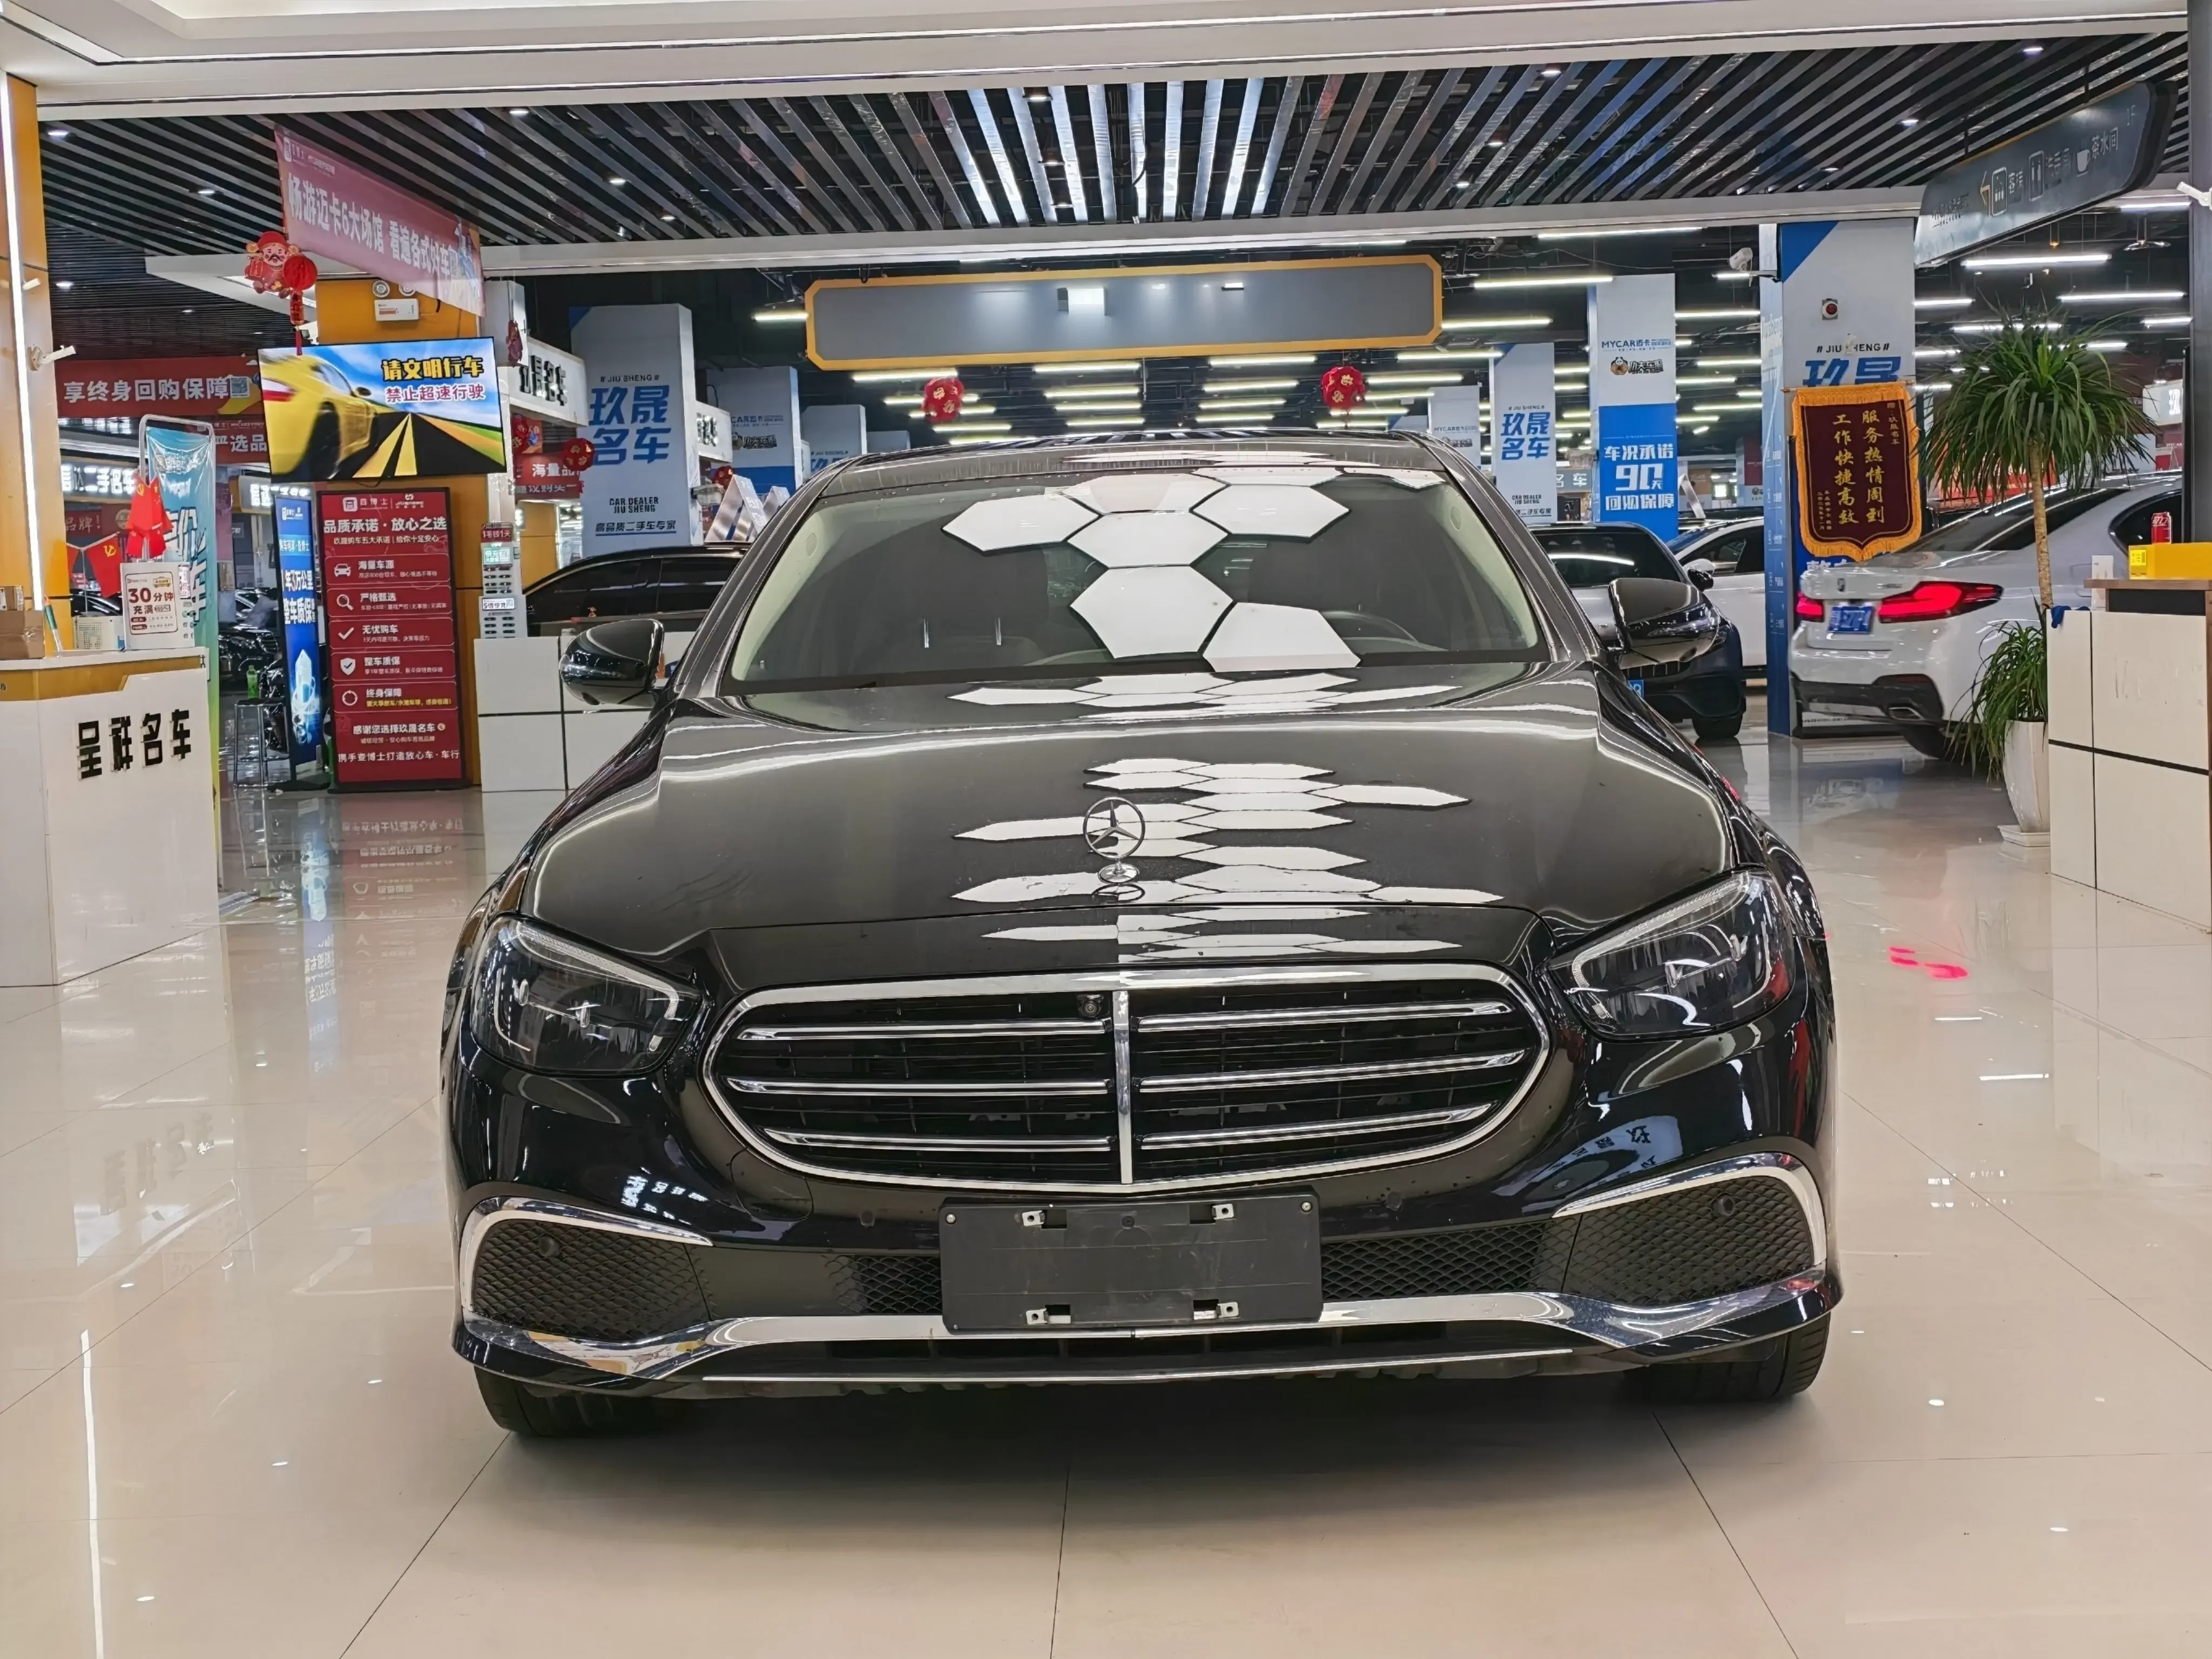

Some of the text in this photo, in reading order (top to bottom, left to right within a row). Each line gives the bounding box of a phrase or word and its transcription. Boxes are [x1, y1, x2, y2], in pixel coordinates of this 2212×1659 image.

[2092, 127, 2119, 159] 茶水间
[288, 172, 385, 254] 畅游迈卡6大场馆
[1826, 345, 1842, 353] JIU
[381, 355, 484, 381] 请文明行车
[623, 374, 652, 382] SHENG
[63, 376, 231, 403] 享终身回购保障
[385, 382, 484, 403] 禁止超速行驶
[588, 385, 670, 426] 玖晟
[1500, 412, 1551, 436] 玖晟
[593, 427, 672, 466] 名车
[1501, 436, 1551, 461] 名车
[1604, 443, 1674, 461] 车况承诺
[1862, 409, 1884, 524] 服务热情周到
[609, 497, 659, 505] CAR DEALER
[613, 504, 656, 514] JIU SHENG
[1605, 493, 1675, 510] 回购保障
[595, 520, 677, 533] 高品质二手车专家
[127, 587, 174, 604] 30分钟
[133, 604, 153, 615] 充满
[362, 624, 399, 635] 无忧购车
[364, 656, 400, 666] 整车质保
[366, 688, 402, 698] 终身保障
